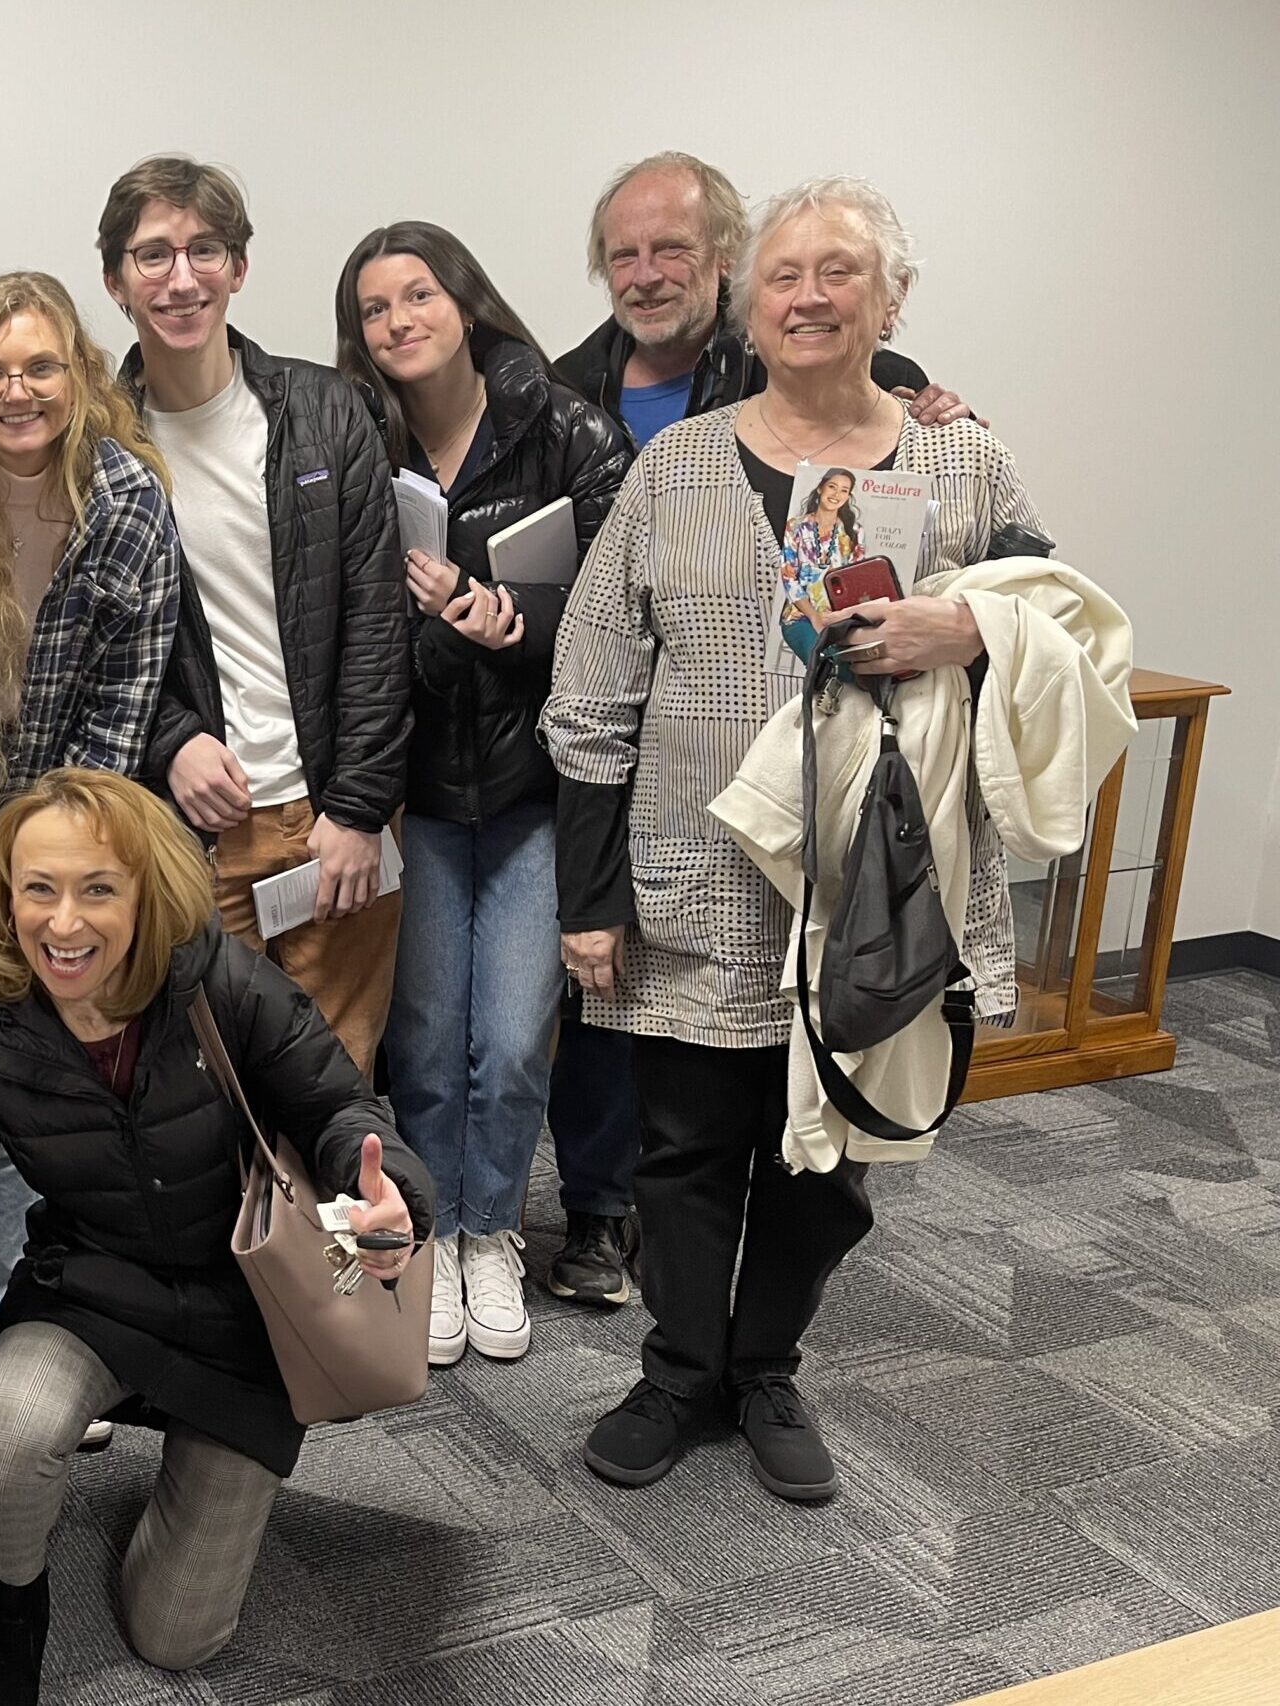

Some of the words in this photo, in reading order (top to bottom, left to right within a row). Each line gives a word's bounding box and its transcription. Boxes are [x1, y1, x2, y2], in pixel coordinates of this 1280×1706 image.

[862, 479, 921, 497] Petalura
[875, 533, 891, 541] FOR
[880, 541, 907, 550] COLOR
